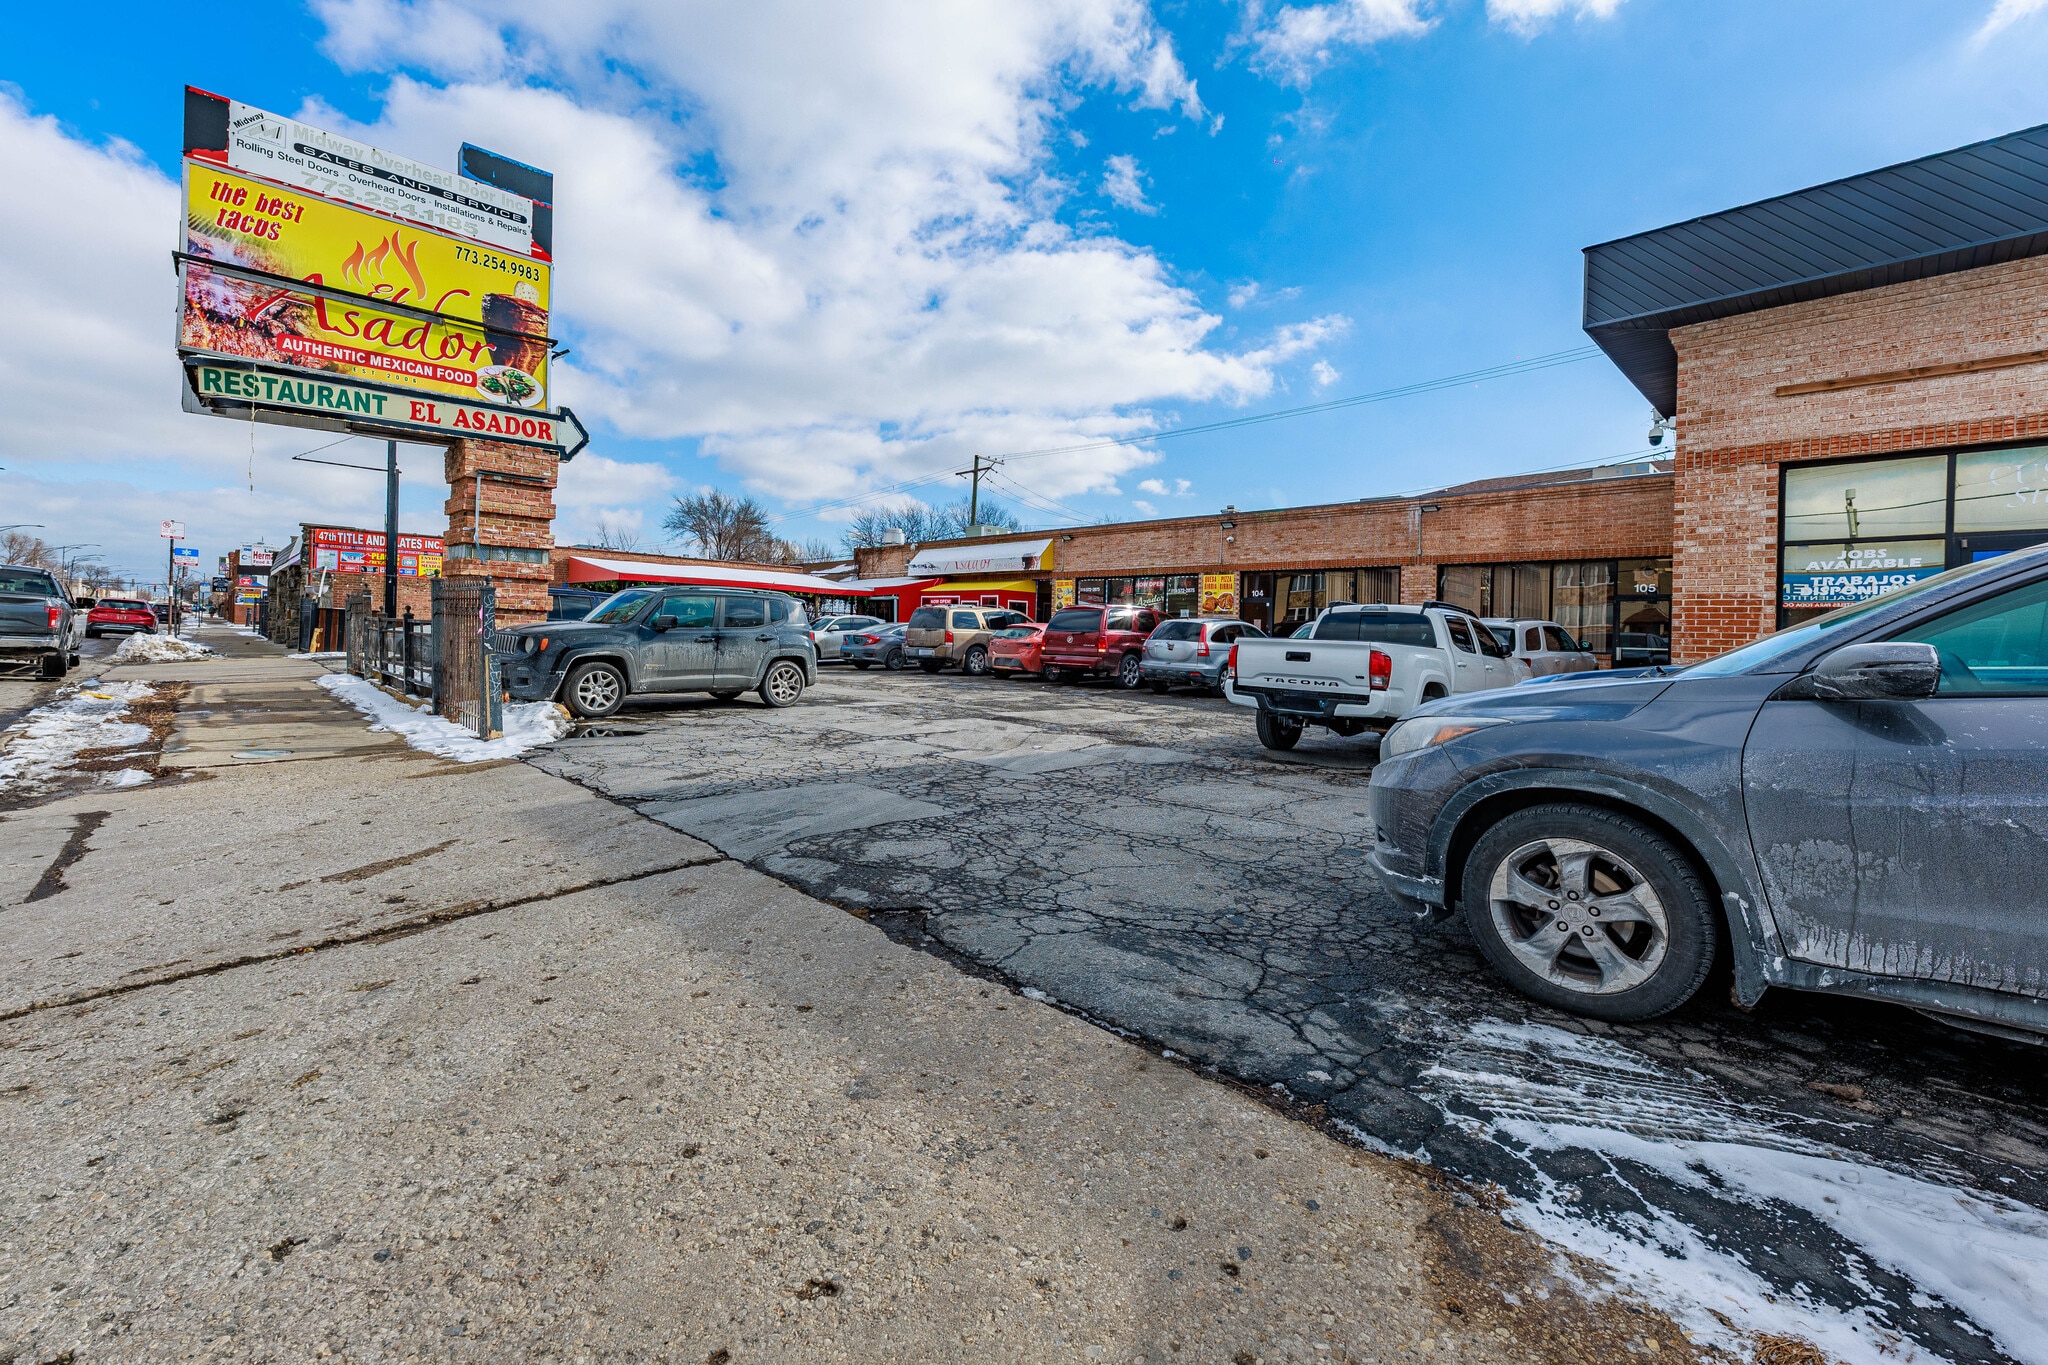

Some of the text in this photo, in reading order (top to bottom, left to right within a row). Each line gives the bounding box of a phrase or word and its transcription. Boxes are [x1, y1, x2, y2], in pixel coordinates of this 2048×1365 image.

[233, 112, 264, 129] Midway
[294, 124, 528, 214] Midway Overhead Door Inc.
[303, 146, 522, 222] SALES AND SERVICE
[209, 180, 305, 223] the best
[236, 139, 273, 158] Rolling
[278, 151, 304, 167] Steel
[308, 160, 339, 177] Doors
[348, 173, 395, 195] Overhead
[398, 189, 426, 204] Doors
[434, 200, 485, 222] Installations
[497, 220, 527, 236] Repairs
[301, 171, 479, 236] 773.254.1185
[216, 208, 282, 241] tacos
[455, 246, 540, 282] 773.254.9983
[250, 273, 497, 364] Asador
[282, 337, 473, 384] AUTHENTIC MEXICAN FOOD
[352, 366, 376, 376] EST
[203, 368, 553, 441] RESTAURANT EL ASADOR
[318, 531, 336, 542] 47th
[338, 532, 364, 545] TITLE
[366, 534, 386, 546] AND
[424, 539, 443, 550] INC.
[1836, 548, 1888, 560] JOBS
[1805, 557, 1923, 571] AVAILABLE
[1810, 574, 1917, 587] TRABAJOS
[1252, 589, 1264, 597] 104
[1634, 583, 1657, 593] 105
[1264, 676, 1339, 688] TACOMA
